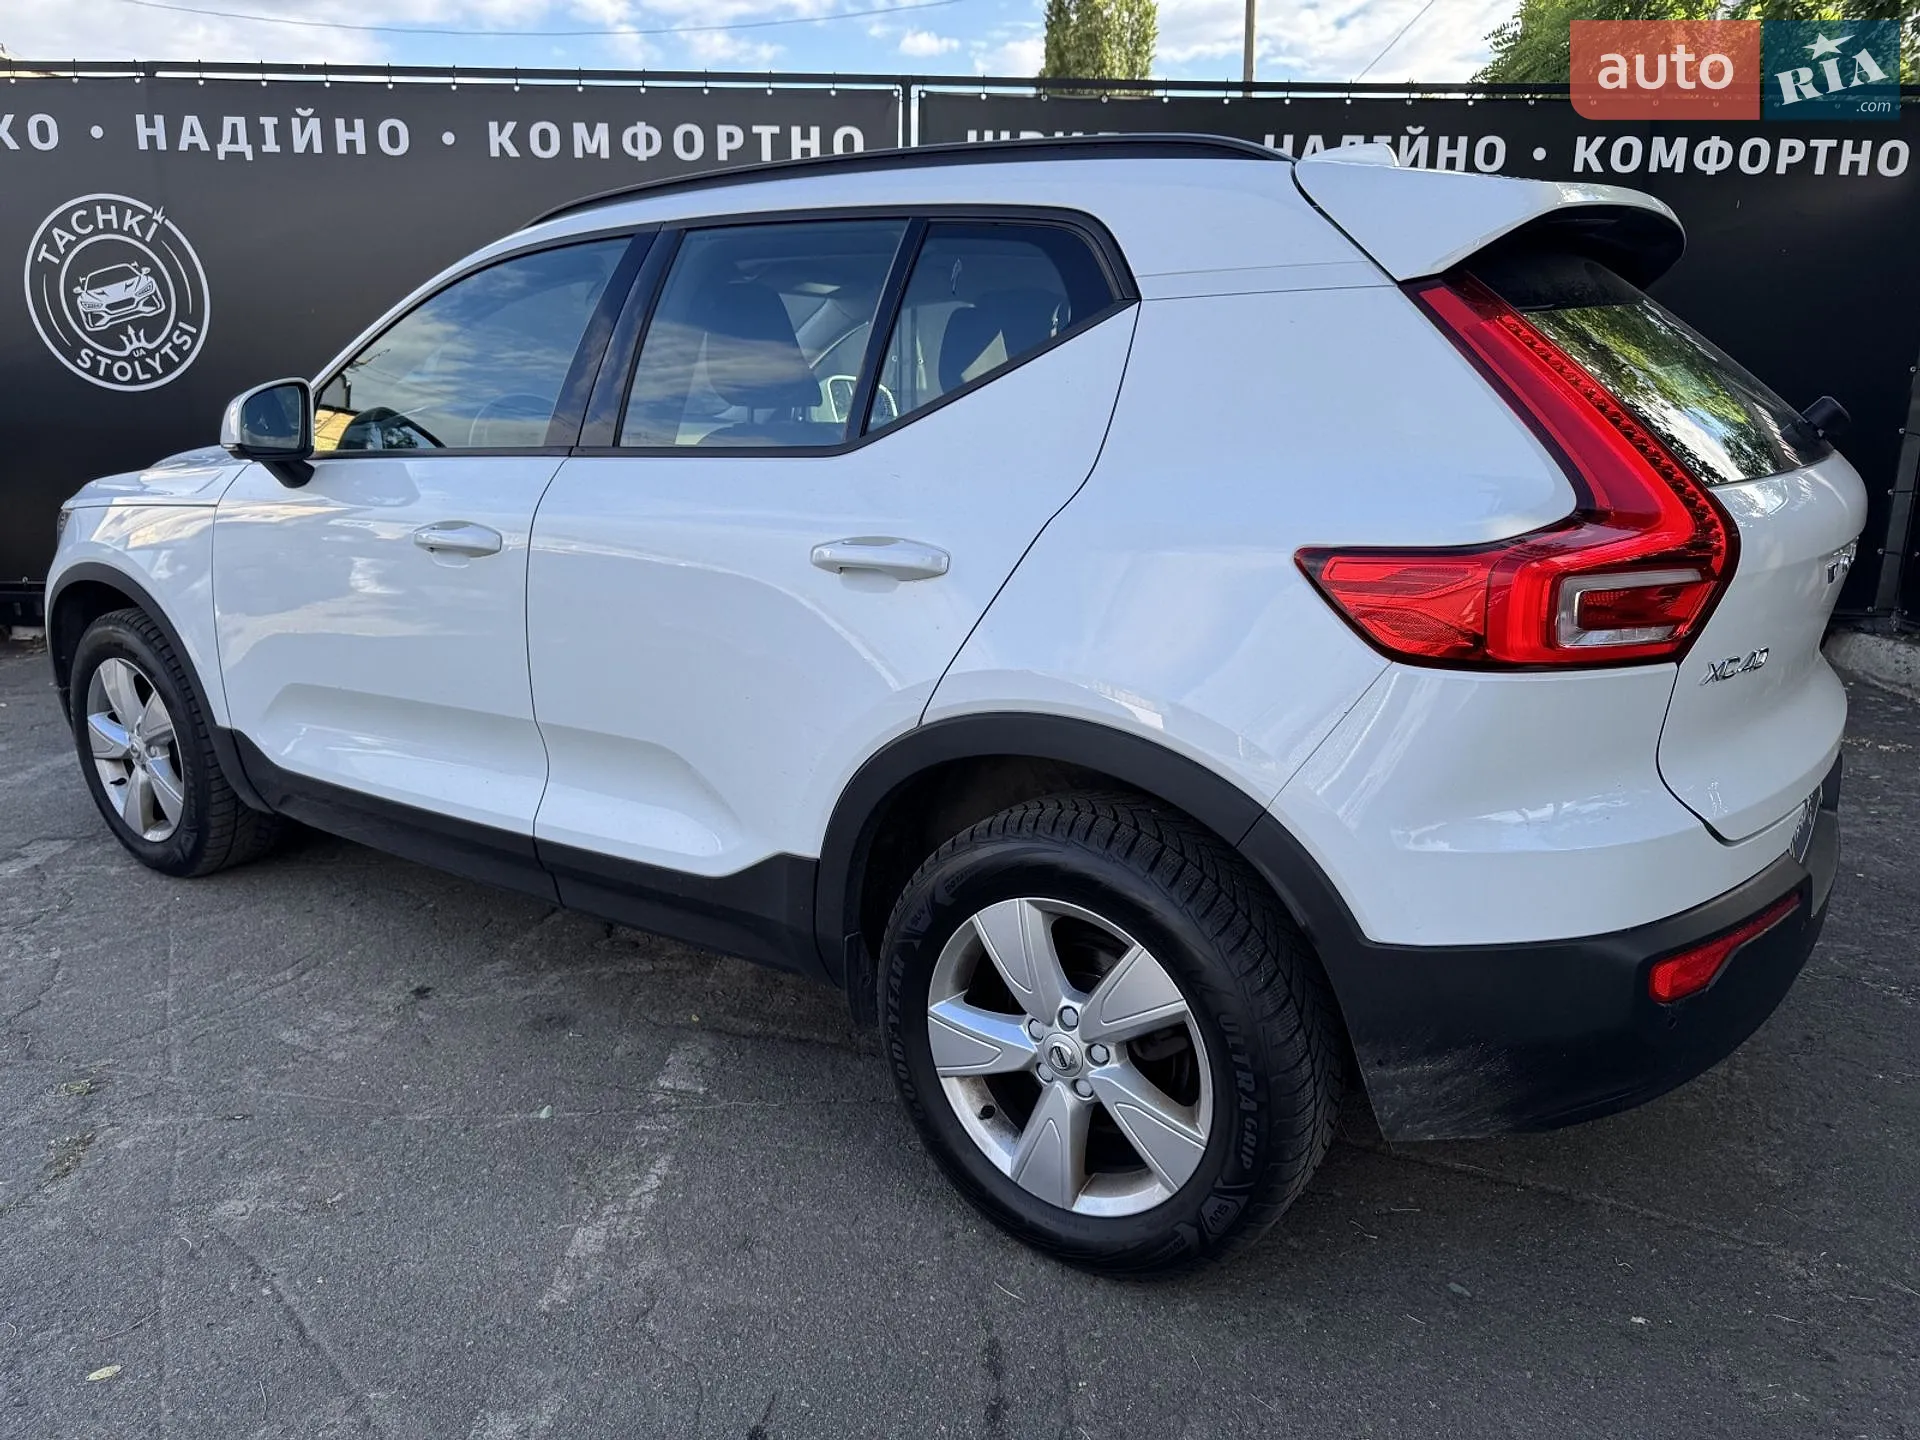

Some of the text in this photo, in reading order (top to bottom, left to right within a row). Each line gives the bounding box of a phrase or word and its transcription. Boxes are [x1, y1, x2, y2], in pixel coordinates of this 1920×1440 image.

[136, 108, 410, 161] НАДІЙНО
[488, 120, 866, 162] КОМФОРТНО
[1573, 135, 1911, 177] КОМФОРТНО
[37, 205, 159, 265] TACHKI
[76, 321, 198, 382] STOLYTSI
[1700, 647, 1769, 686] XC40
[1217, 1012, 1260, 1171] ULTRA GRIP
[1209, 1203, 1230, 1227] SUV
